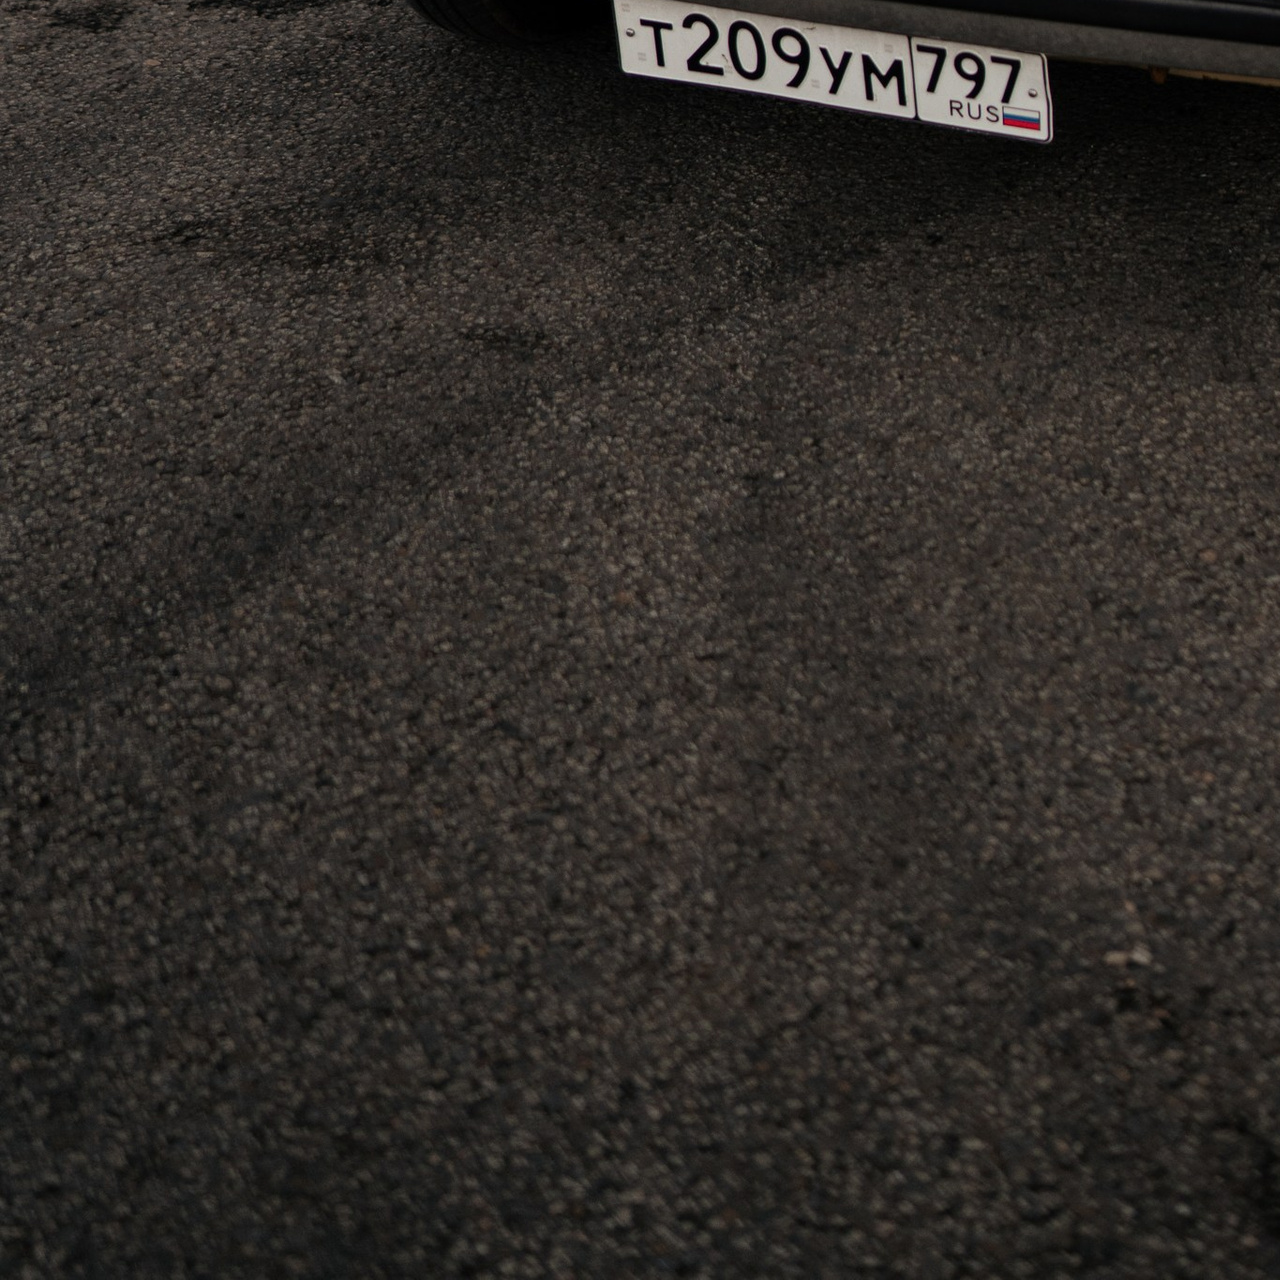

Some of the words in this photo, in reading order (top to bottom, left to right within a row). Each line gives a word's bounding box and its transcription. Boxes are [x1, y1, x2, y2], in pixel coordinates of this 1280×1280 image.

[639, 12, 907, 107] Т209УМ
[916, 44, 1022, 105] 797
[949, 99, 1000, 123] RUS
